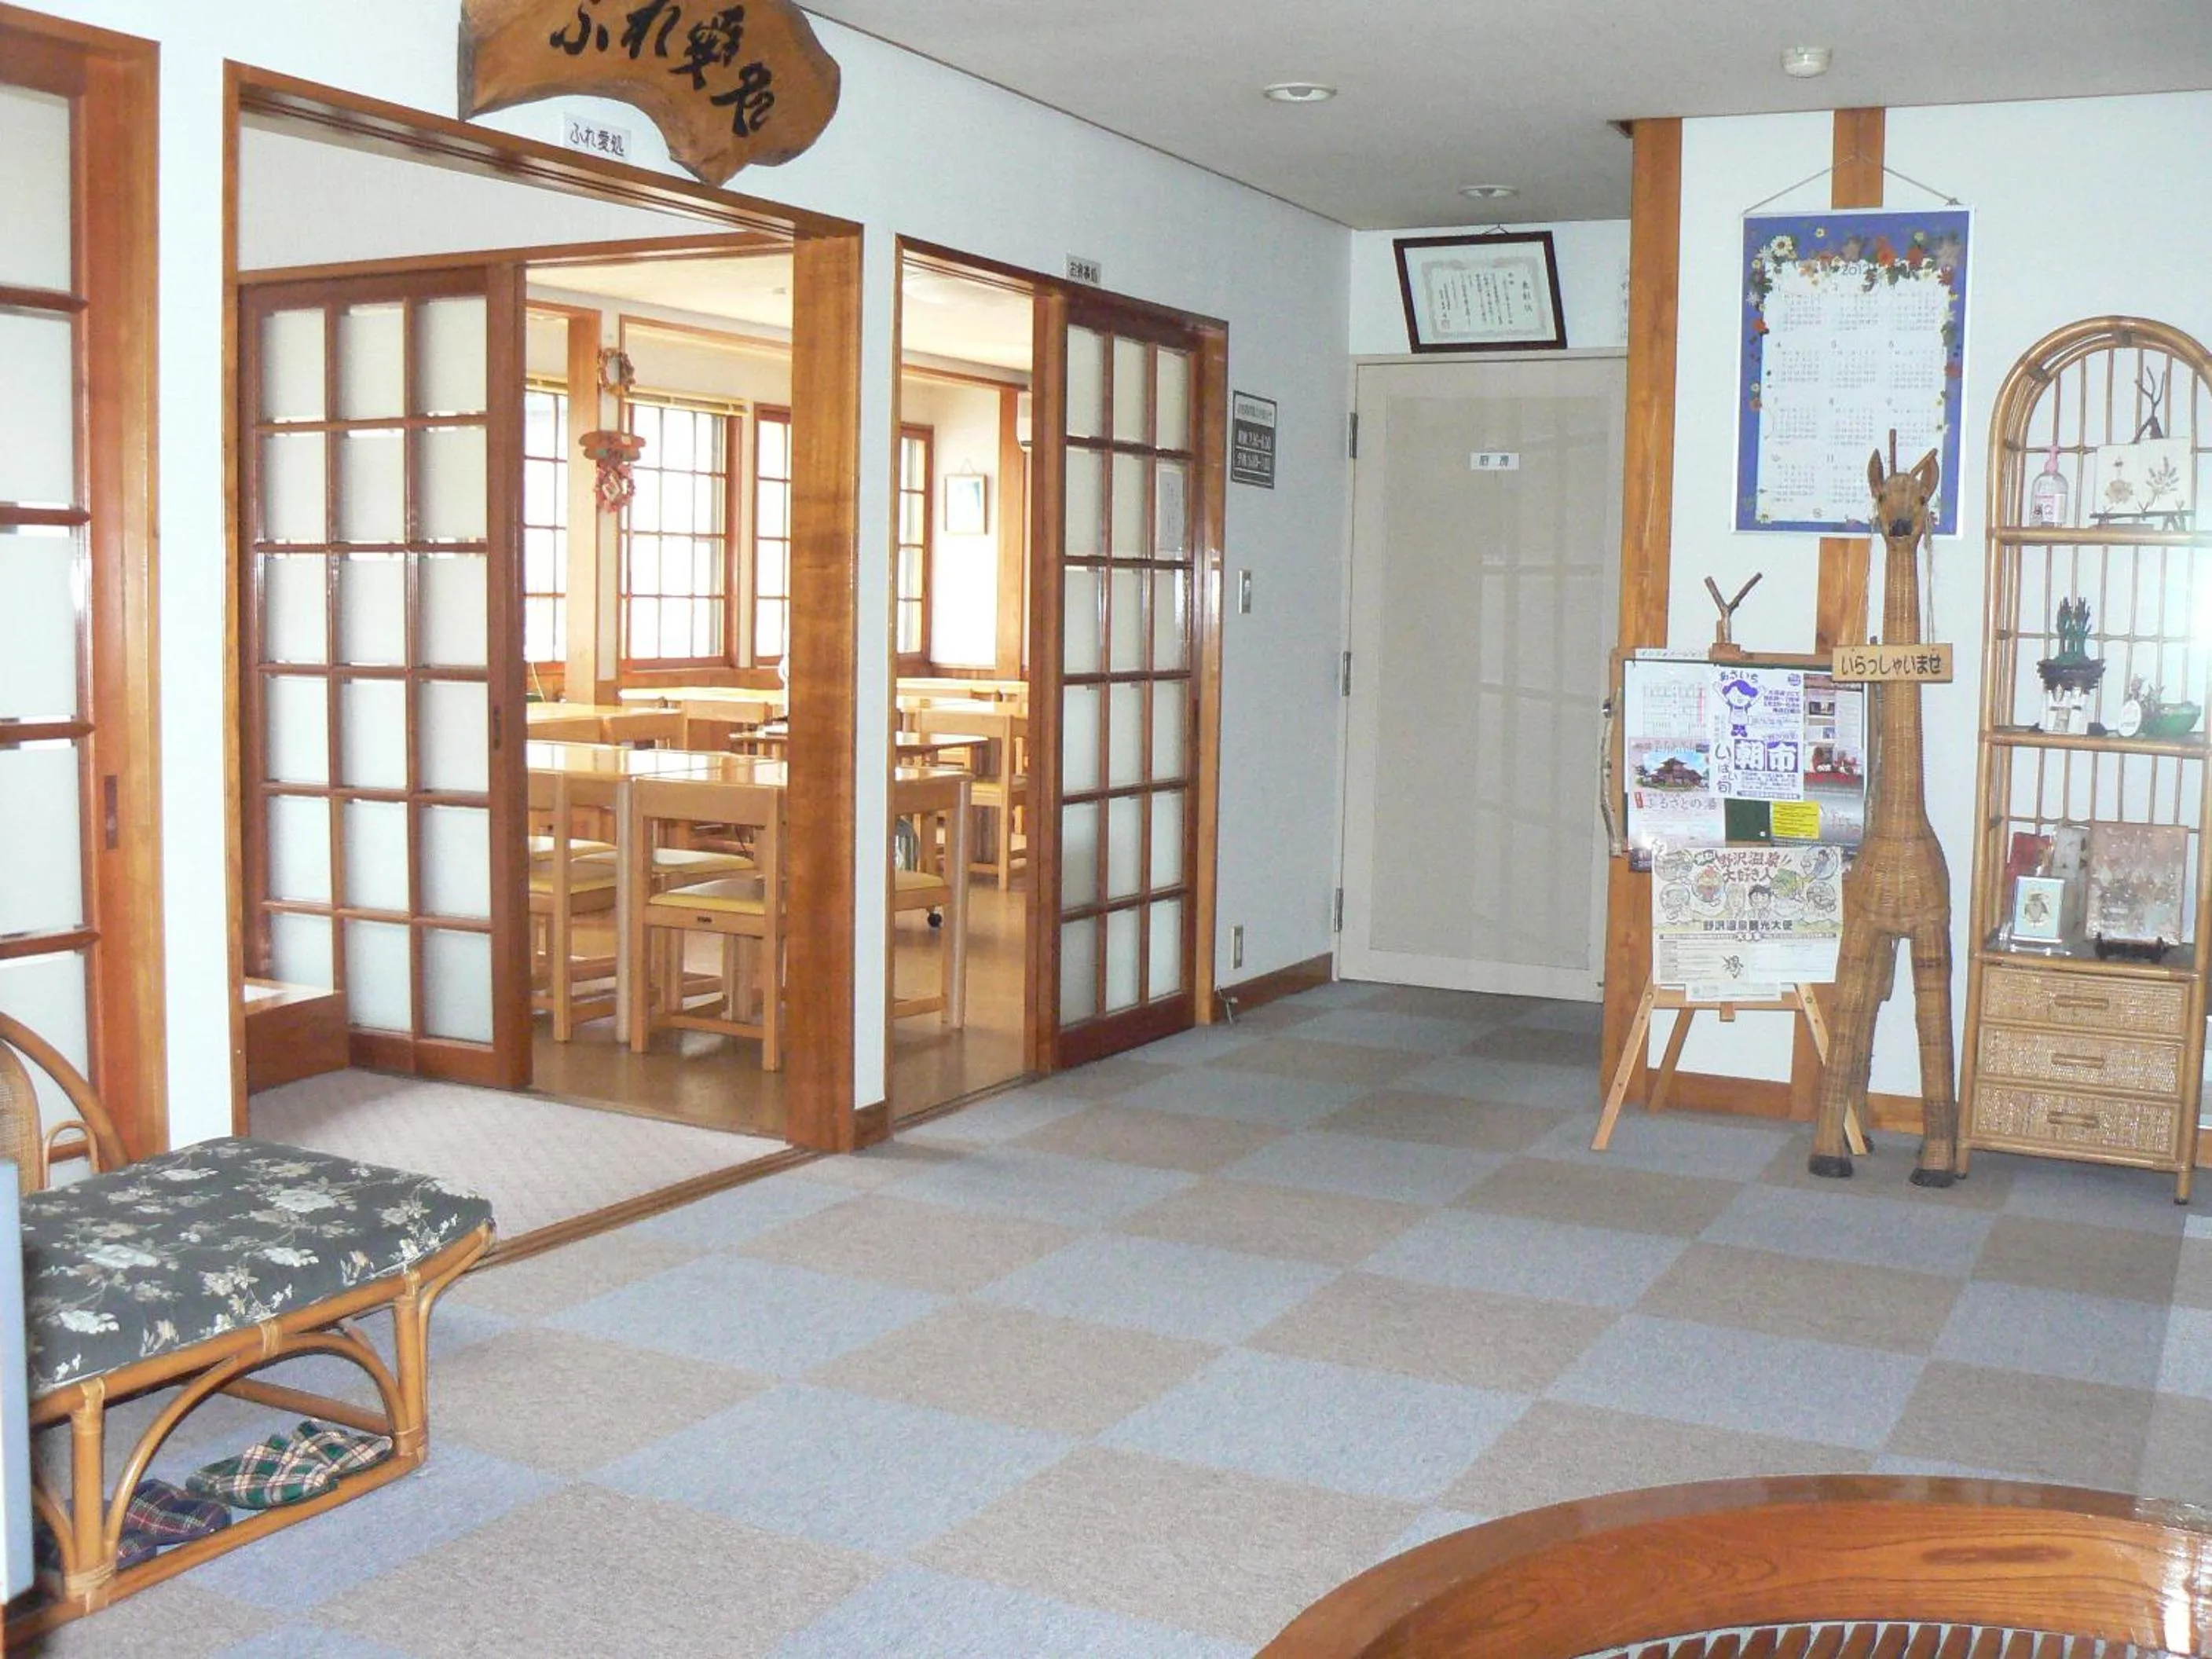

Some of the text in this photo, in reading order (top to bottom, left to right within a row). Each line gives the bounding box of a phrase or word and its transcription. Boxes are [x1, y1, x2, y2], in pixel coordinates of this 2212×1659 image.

[570, 123, 624, 156] ふれ愛処
[1841, 654, 1942, 675] いらっしゃいませ
[1734, 738, 1798, 773] 朝市
